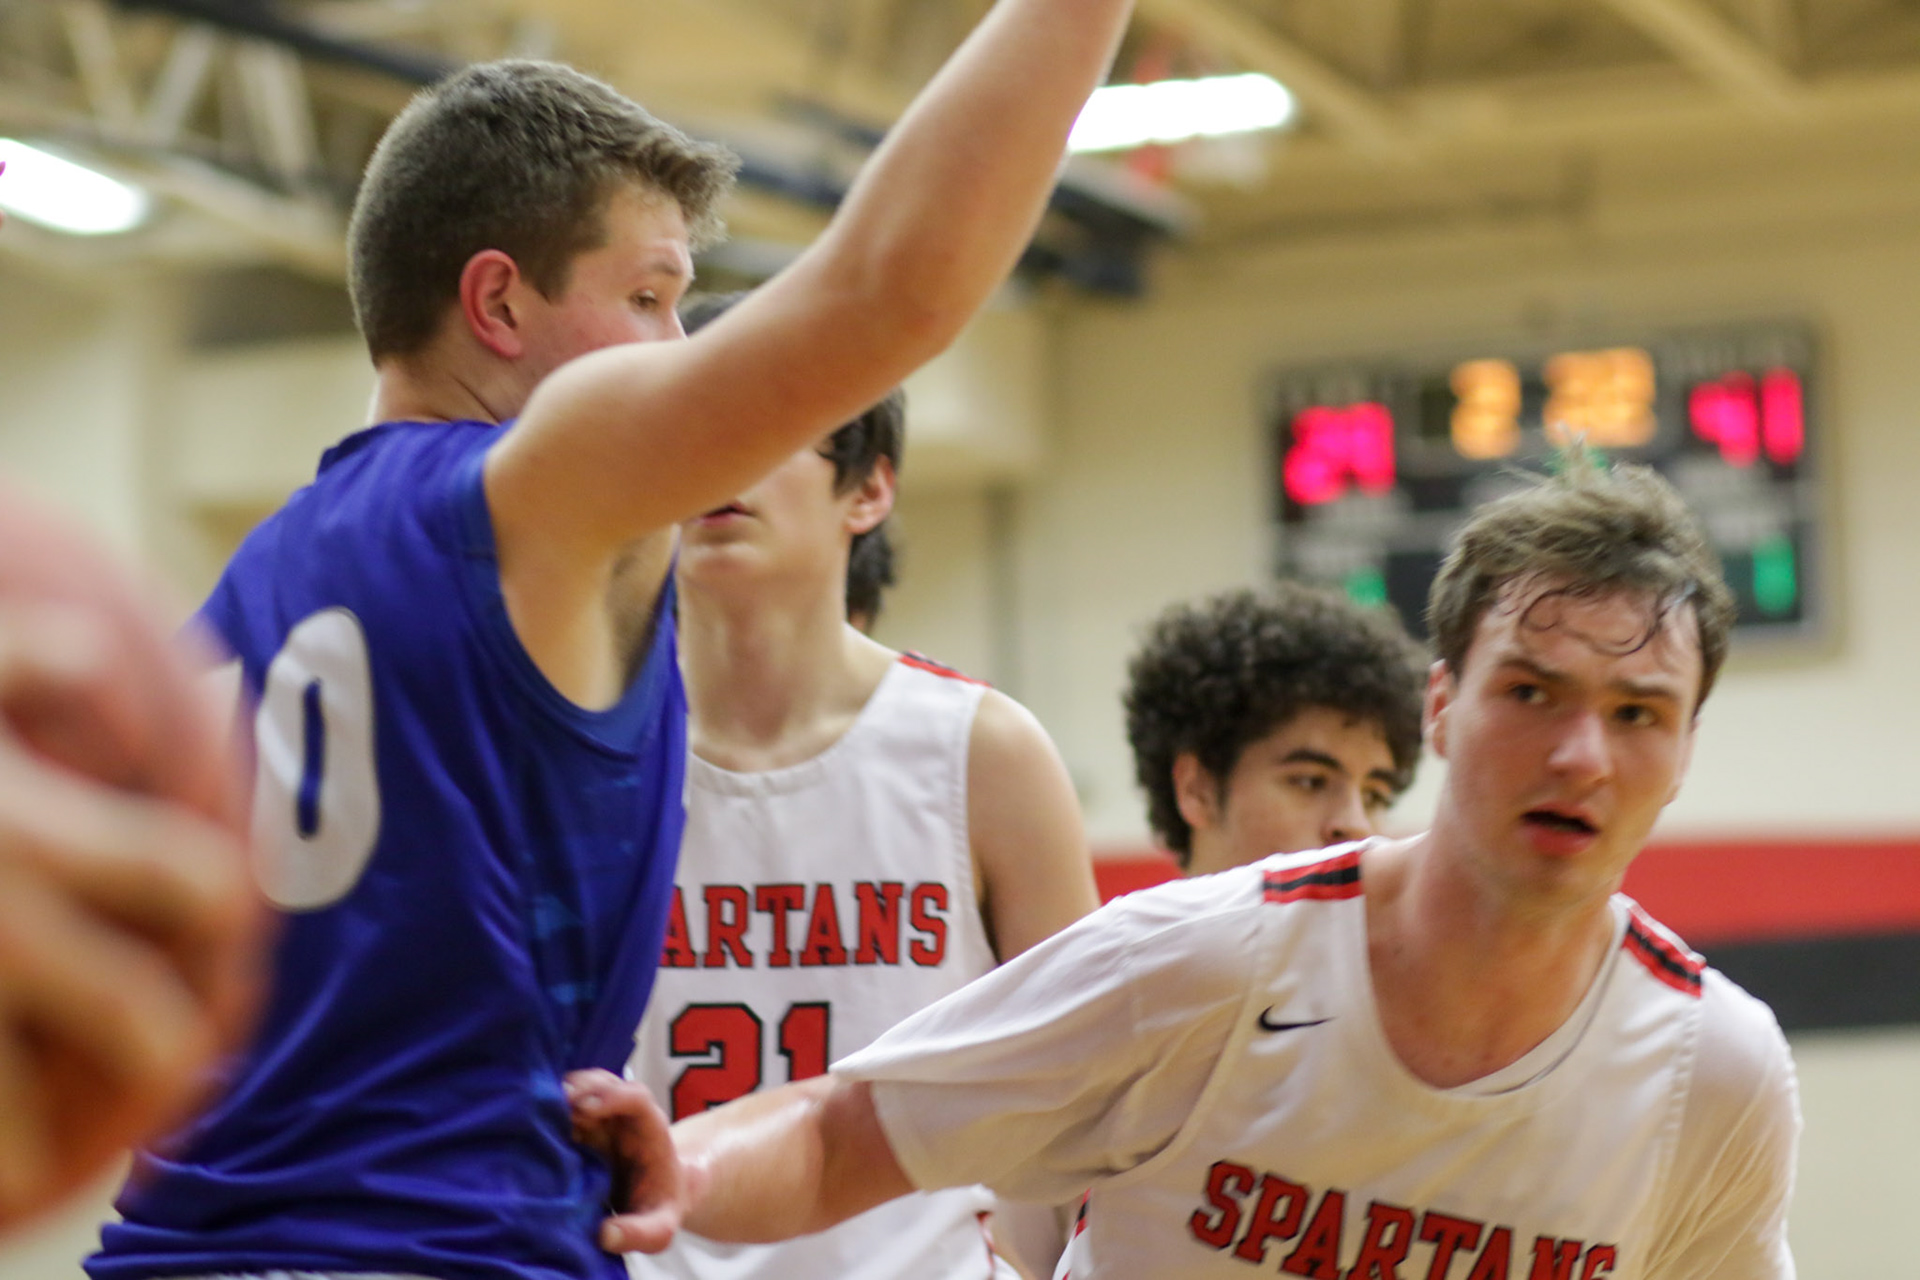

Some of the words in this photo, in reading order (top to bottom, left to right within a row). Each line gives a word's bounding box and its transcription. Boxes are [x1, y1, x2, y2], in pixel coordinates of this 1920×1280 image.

[203, 604, 382, 914] 0
[659, 882, 949, 968] ARTANS
[668, 1002, 831, 1124] 21
